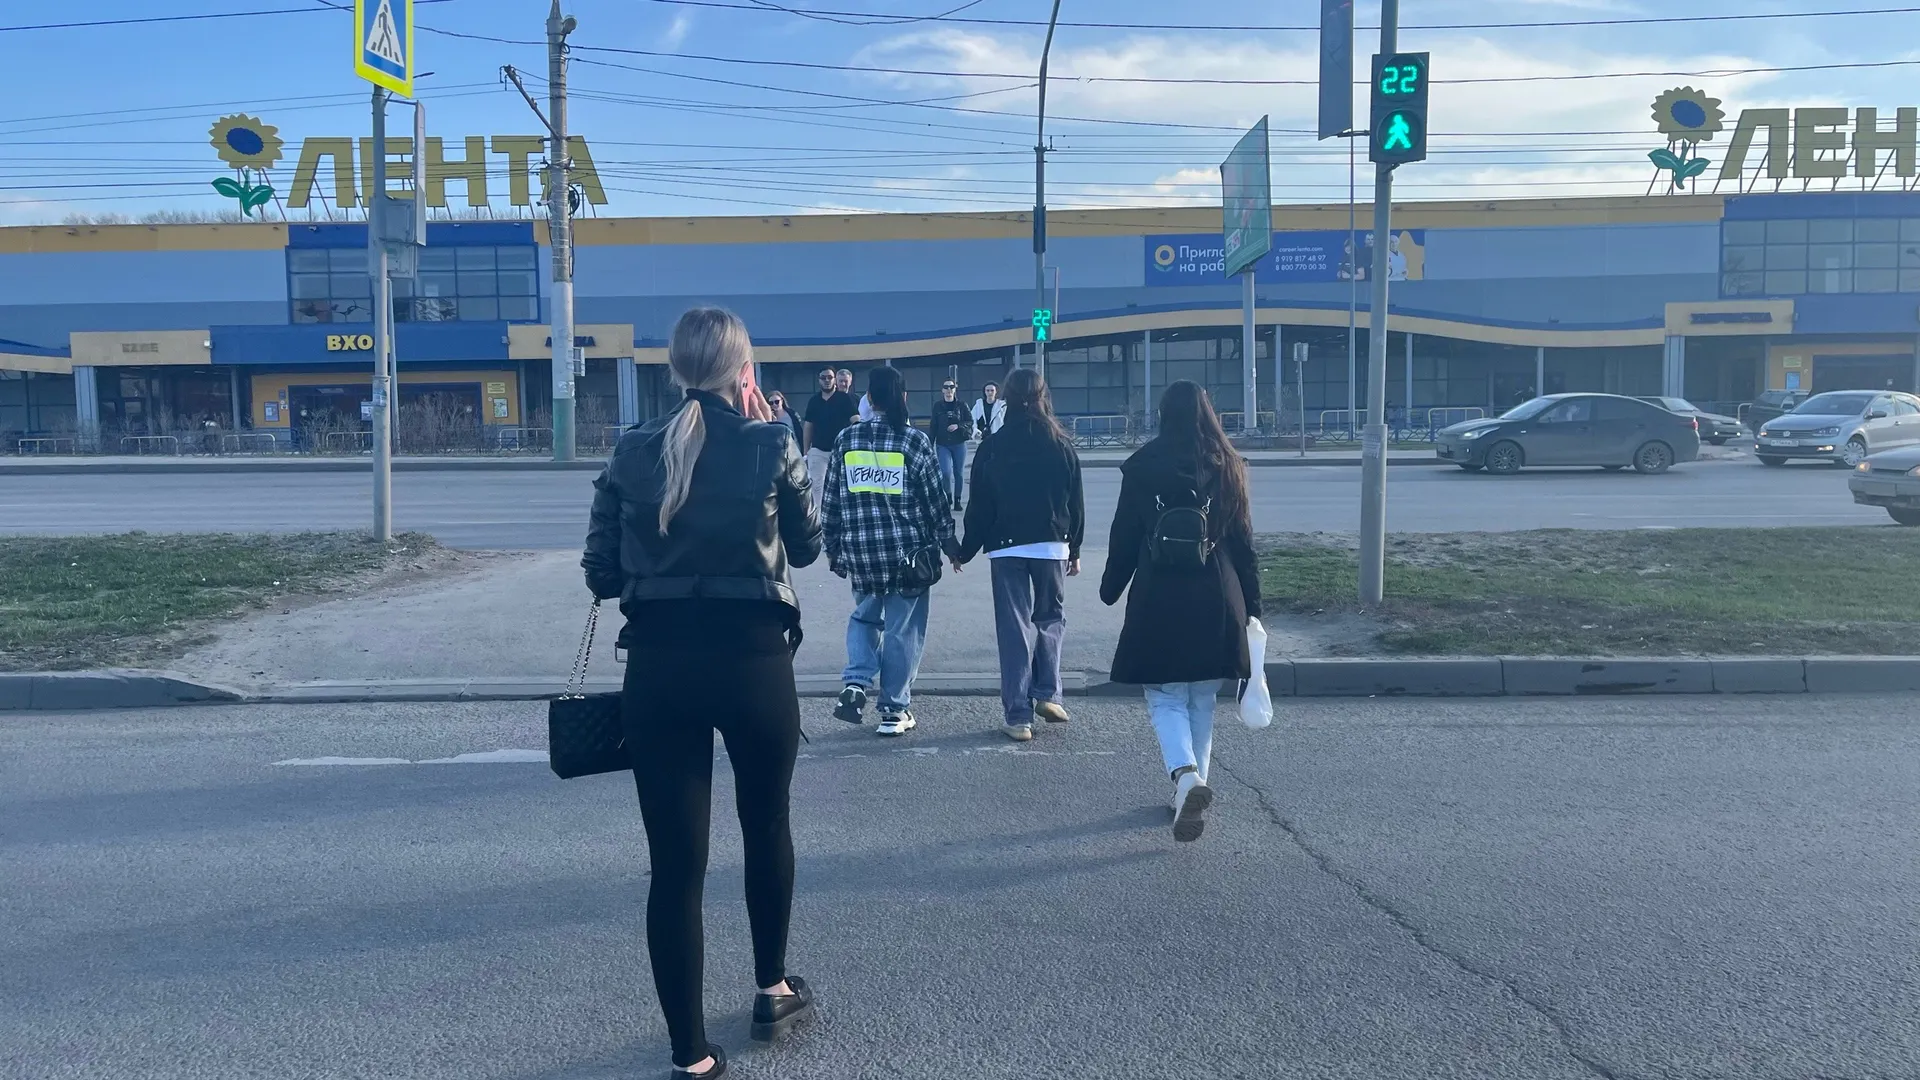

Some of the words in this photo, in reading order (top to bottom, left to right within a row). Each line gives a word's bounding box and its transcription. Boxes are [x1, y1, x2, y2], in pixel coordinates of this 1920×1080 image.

[1382, 65, 1417, 94] 22
[1718, 107, 1917, 179] ЛЕН
[286, 135, 608, 208] ЛЕНТА
[1294, 254, 1306, 262] 817
[1294, 263, 1308, 271] 770
[1180, 263, 1196, 272] на
[1033, 309, 1051, 326] 22
[327, 334, 390, 353] ВХО
